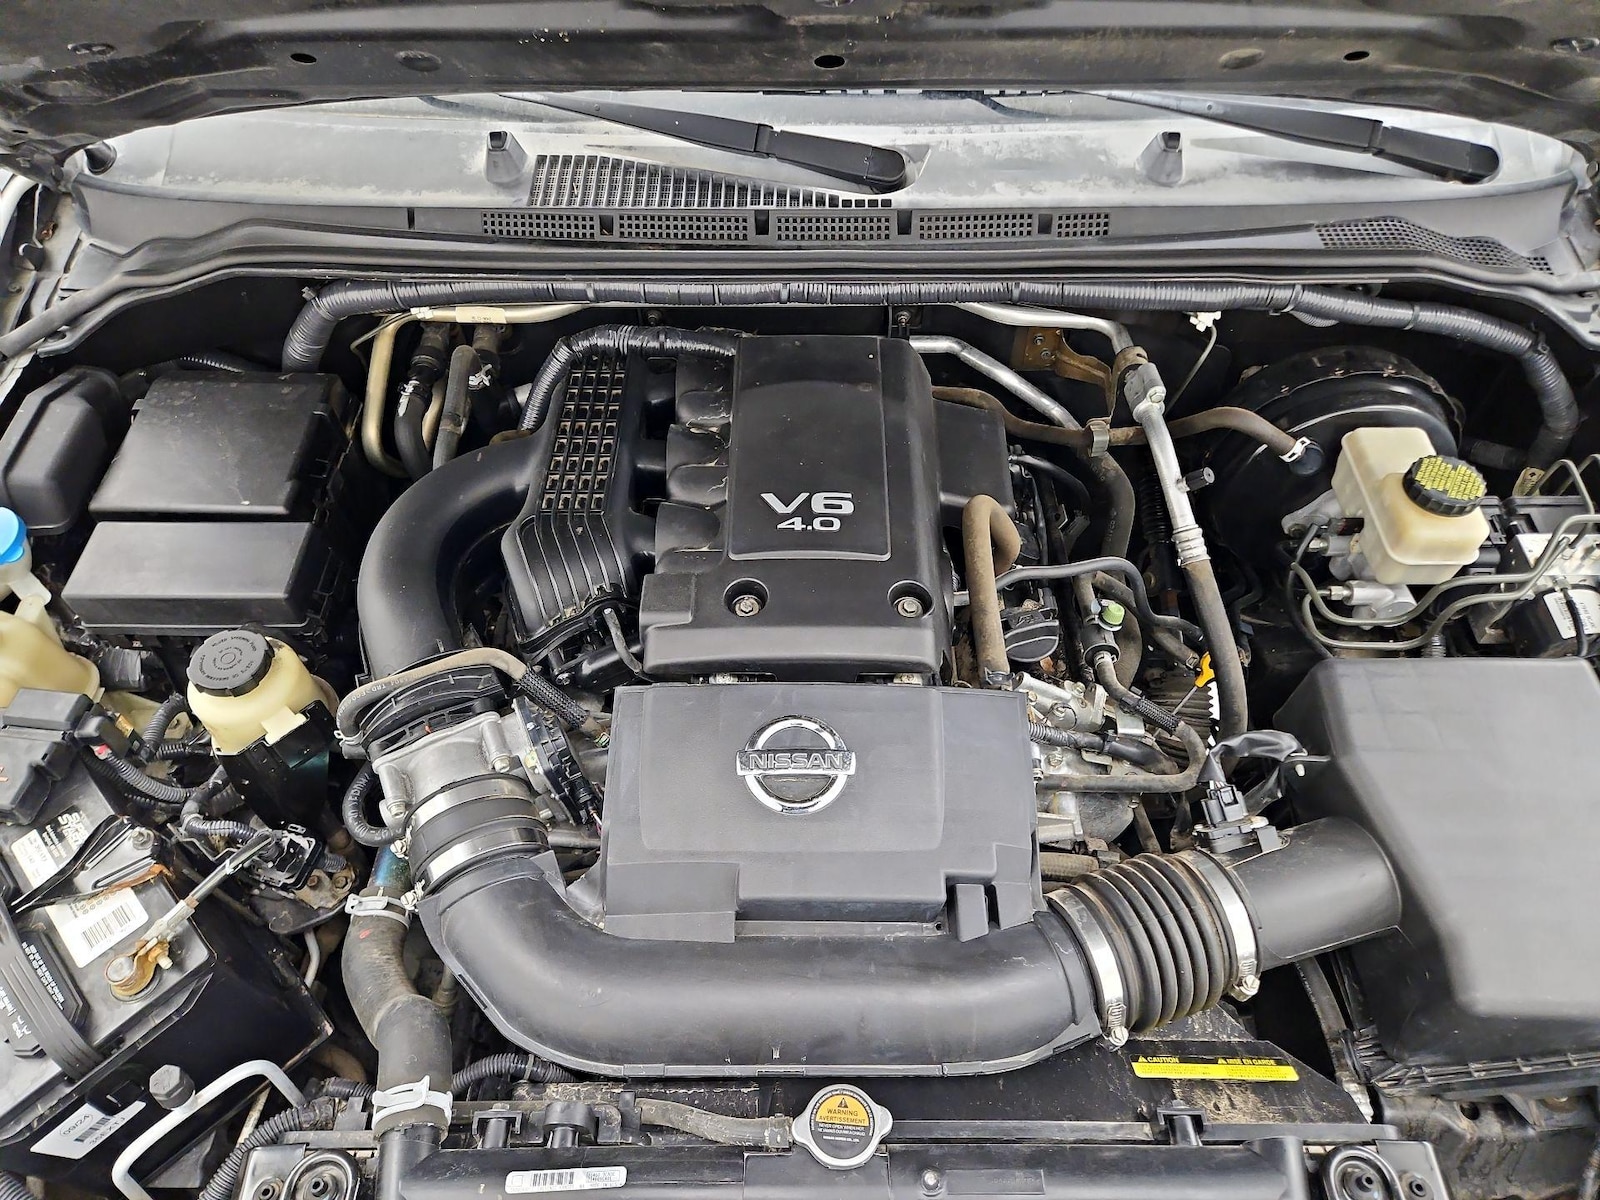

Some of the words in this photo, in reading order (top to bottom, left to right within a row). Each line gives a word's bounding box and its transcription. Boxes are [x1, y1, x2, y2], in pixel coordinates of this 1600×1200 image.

[760, 492, 854, 514] V6
[776, 516, 841, 531] 4.0
[749, 753, 843, 769] NISSAN
[1253, 1058, 1277, 1066] GARDE
[827, 1108, 858, 1116] WARNING
[819, 1116, 865, 1124] AVERTISSEMENT
